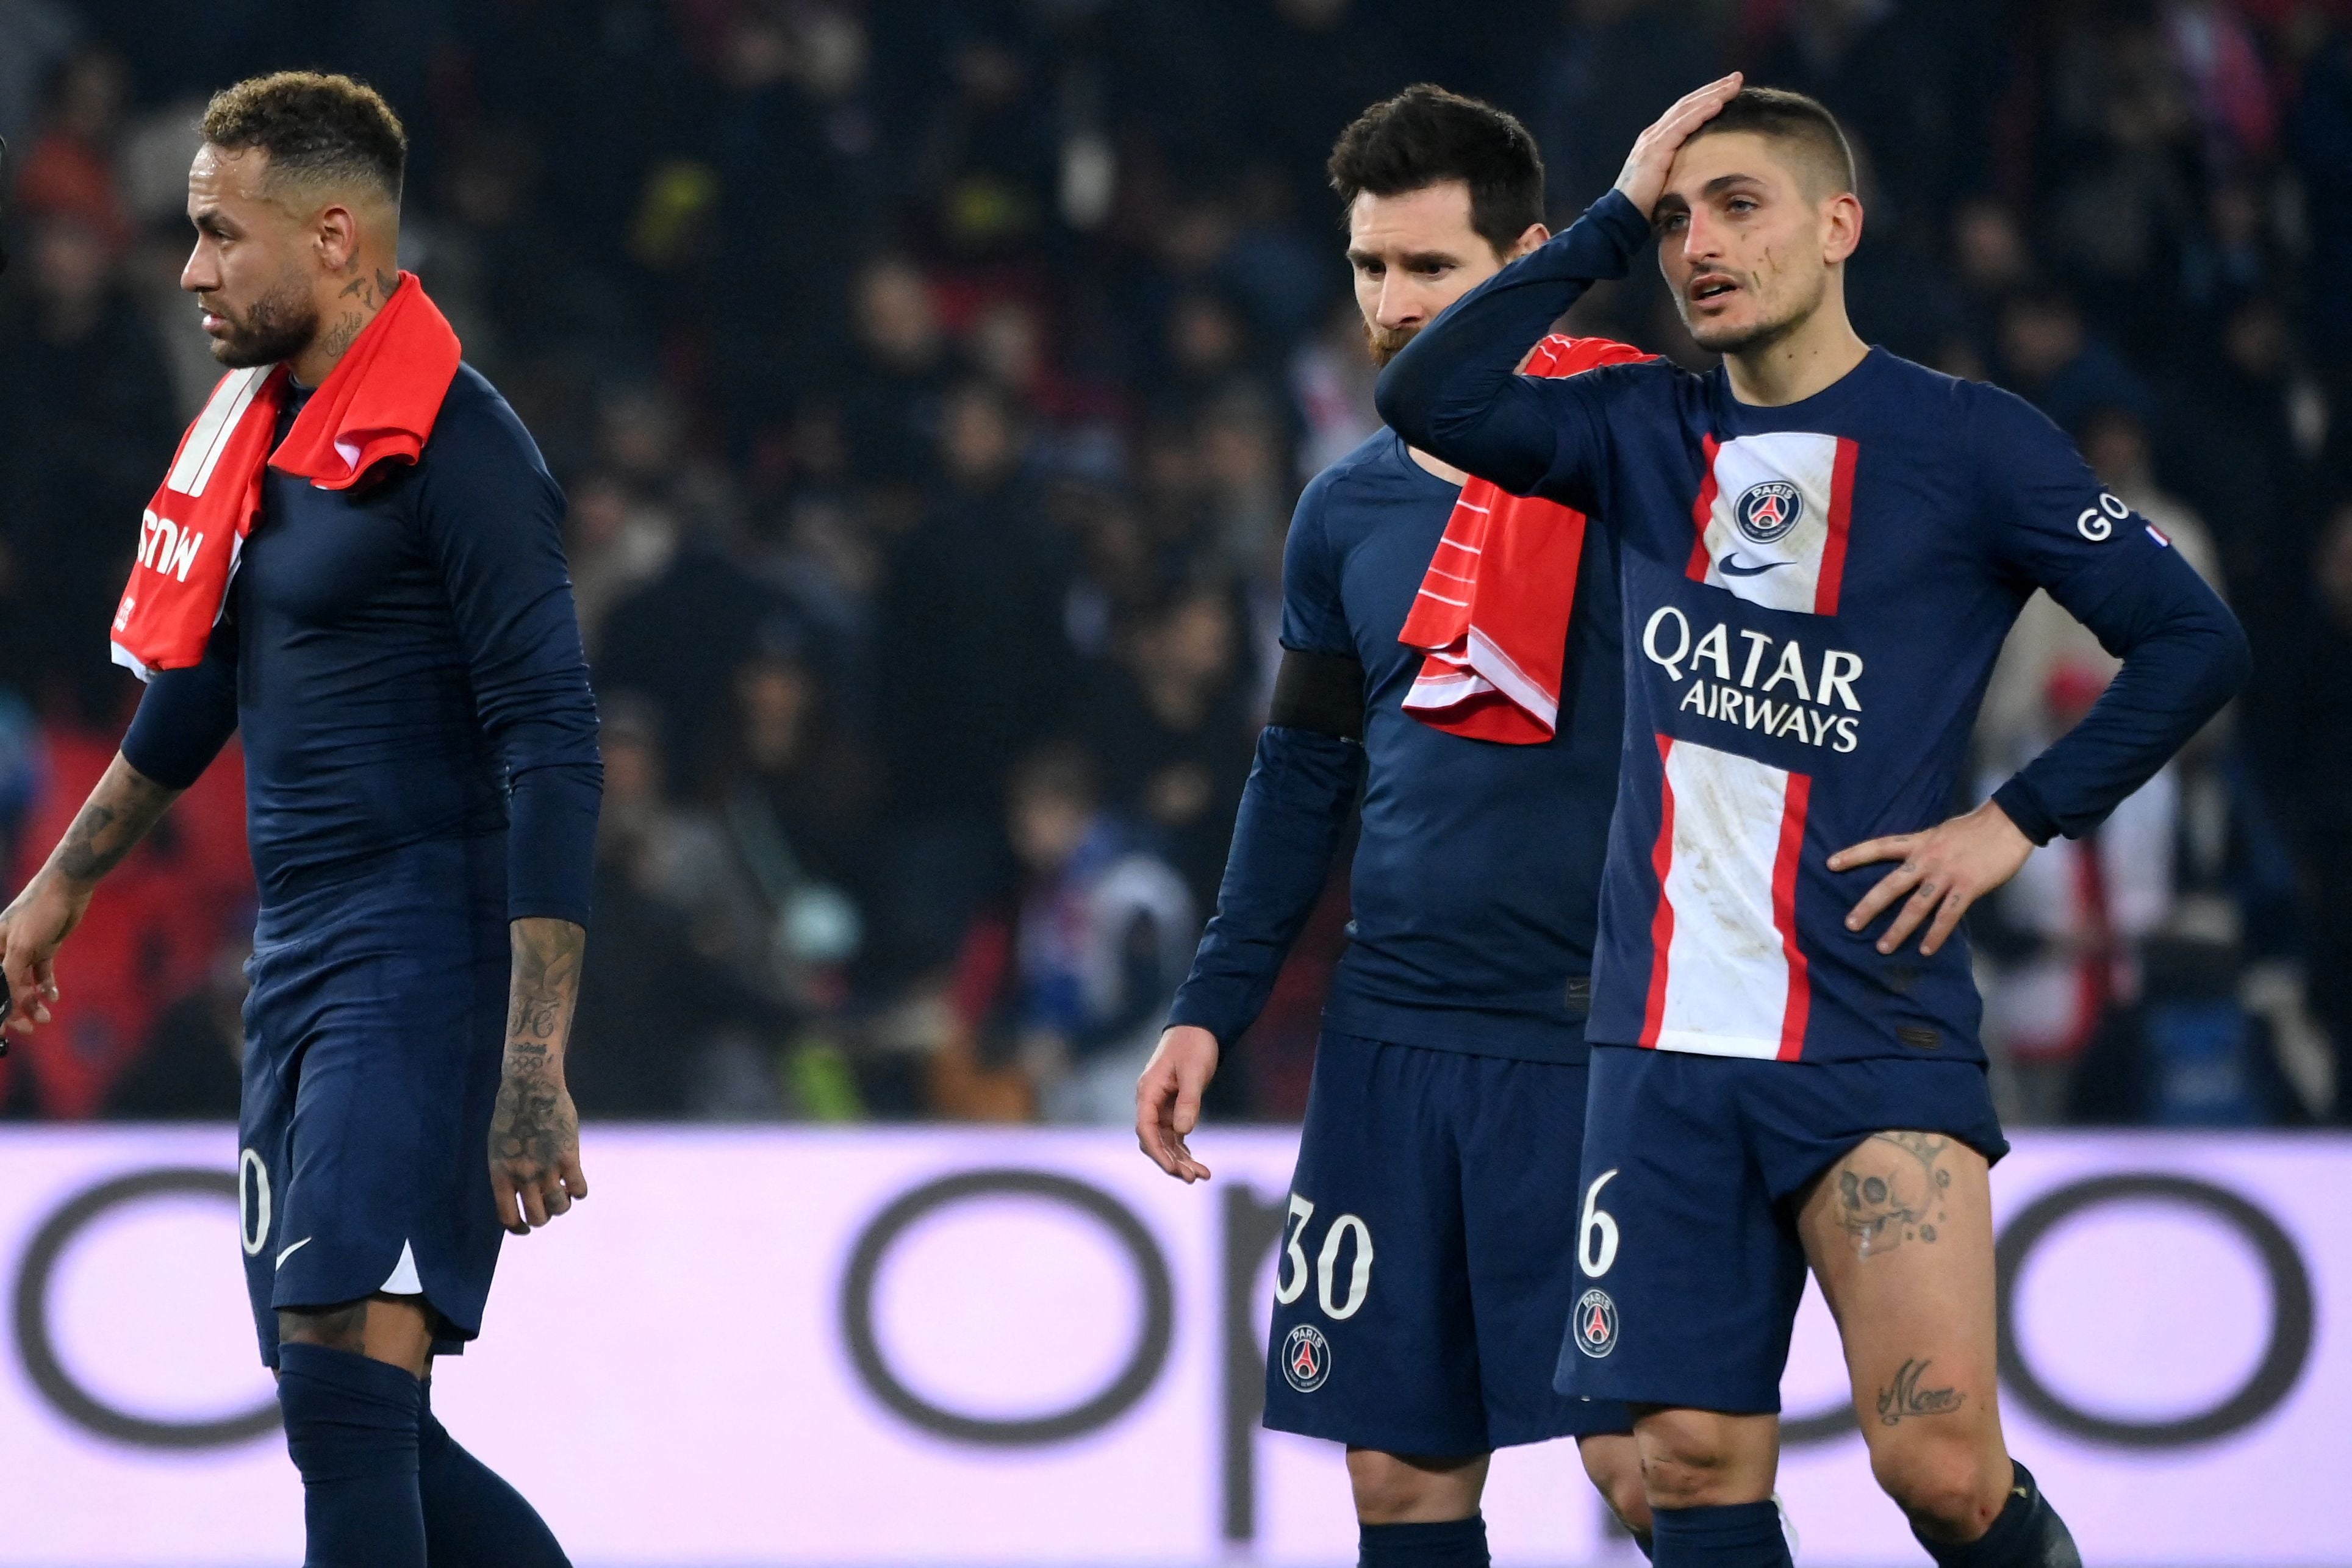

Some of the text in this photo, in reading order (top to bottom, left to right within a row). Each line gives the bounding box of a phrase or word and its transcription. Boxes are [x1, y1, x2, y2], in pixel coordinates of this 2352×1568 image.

[1751, 485, 1793, 499] PARIS
[2077, 492, 2129, 542] GO
[1643, 606, 1864, 712] QATAR
[1680, 679, 1859, 754] AIRWAYS
[1578, 1169, 1619, 1278] 6
[1275, 1194, 1374, 1320] 30
[1582, 1292, 1611, 1311] PARIS
[1292, 1328, 1323, 1348] PARIS
